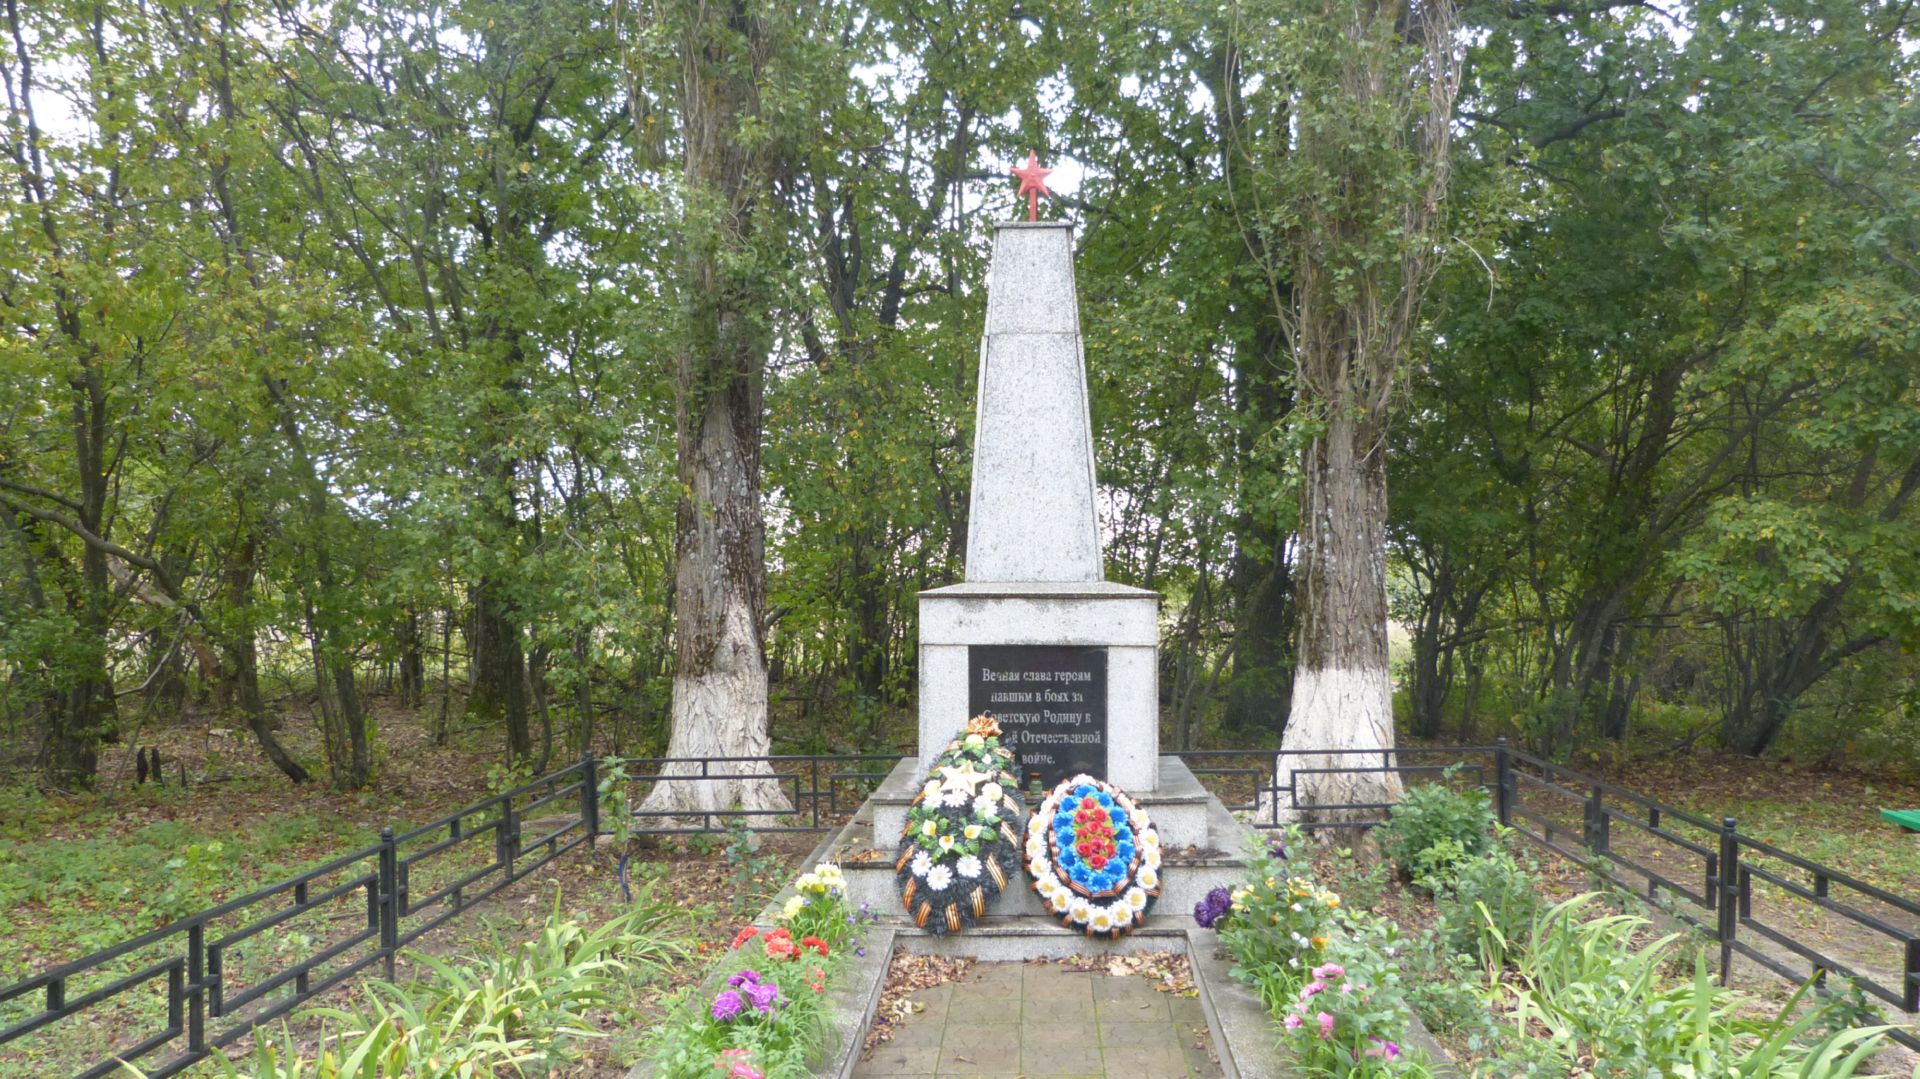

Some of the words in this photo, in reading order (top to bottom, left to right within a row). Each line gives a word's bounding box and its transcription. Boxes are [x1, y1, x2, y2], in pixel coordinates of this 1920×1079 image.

[982, 668, 1020, 682] Вечная
[1023, 671, 1052, 682] слава
[1054, 671, 1092, 685] героям
[991, 691, 1033, 703] павшим
[1036, 692, 1042, 702] в
[1044, 688, 1069, 702] боях
[1072, 691, 1084, 702] за
[1043, 709, 1082, 726] Родину
[1085, 713, 1092, 724] в
[1021, 730, 1102, 744] Отечественной
[1022, 752, 1056, 765] войне.
